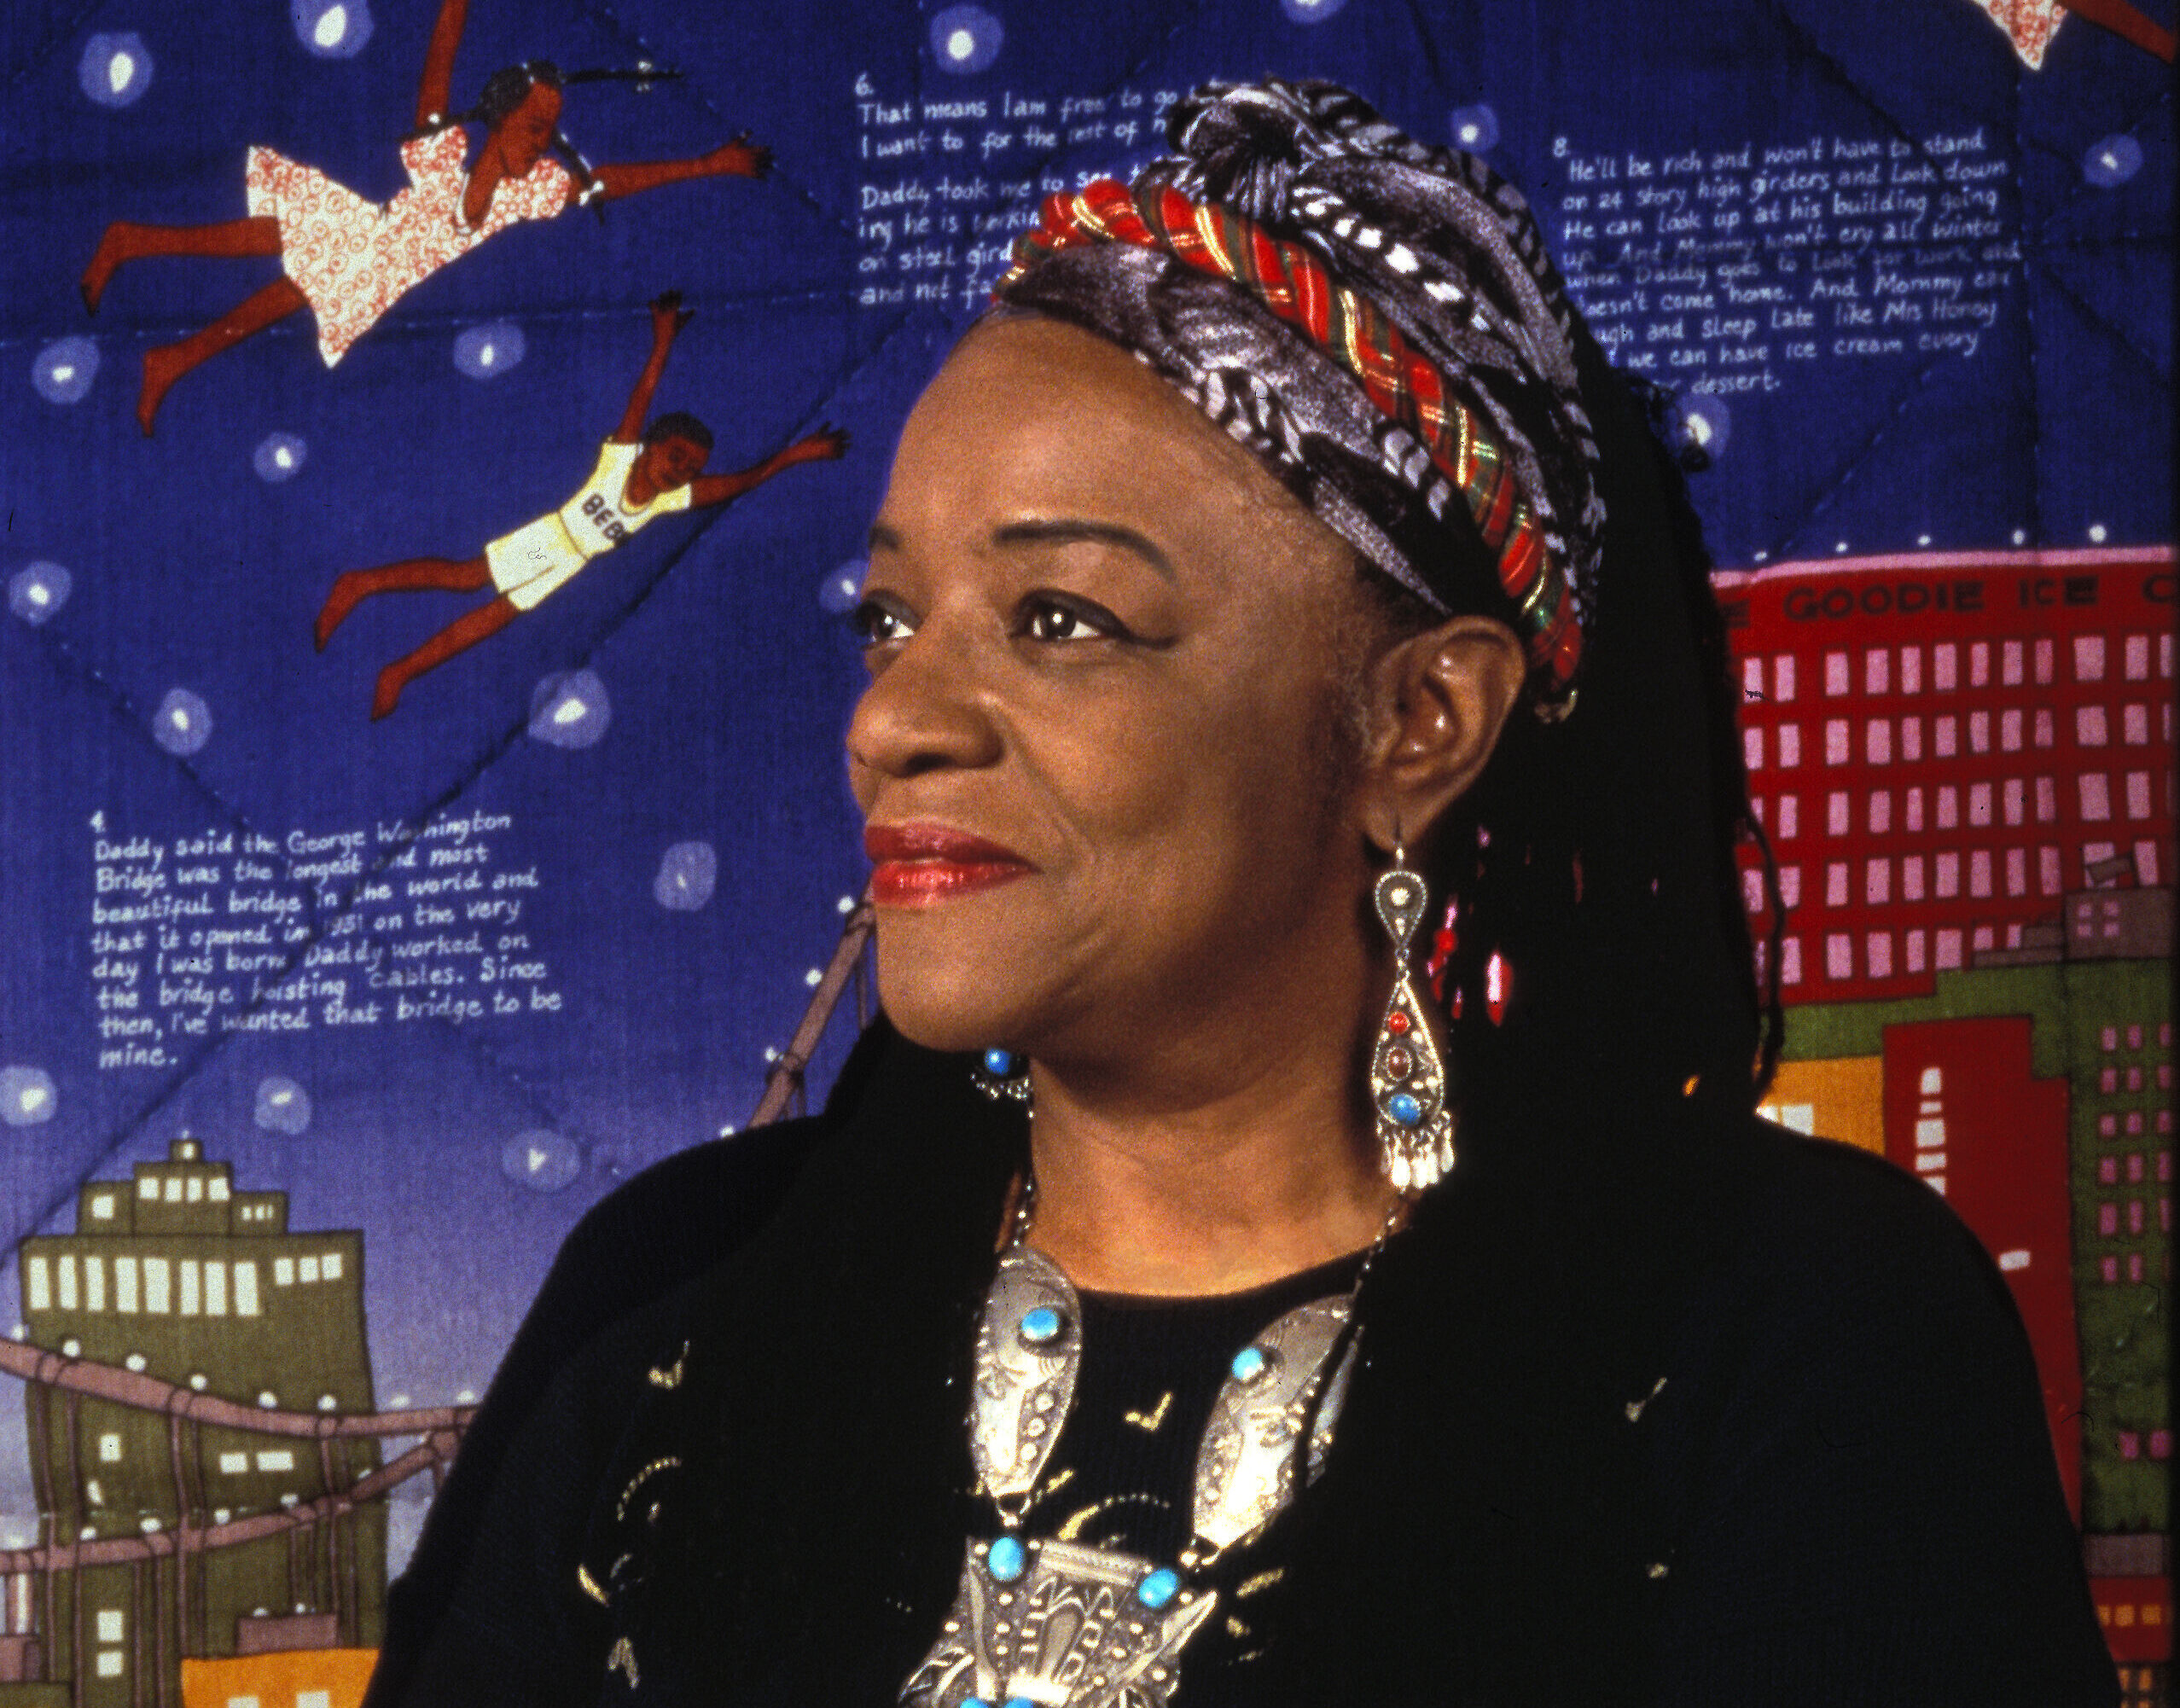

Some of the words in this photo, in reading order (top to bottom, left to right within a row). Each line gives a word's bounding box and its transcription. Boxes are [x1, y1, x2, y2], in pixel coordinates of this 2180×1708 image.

[858, 102, 911, 125] That
[924, 99, 987, 119] means
[1014, 99, 1046, 118] am
[1061, 96, 1106, 123] free
[1120, 87, 1142, 109] to
[1154, 90, 1178, 116] go
[877, 131, 928, 157] want
[942, 129, 964, 150] to
[981, 130, 1013, 160] for
[1024, 125, 1057, 148] the
[1068, 120, 1104, 143] rest
[1113, 120, 1137, 146] of
[1570, 156, 1616, 182] He'll
[1627, 153, 1653, 177] be
[1663, 149, 1703, 176] rich
[1712, 141, 1751, 170] and
[1764, 137, 1822, 165] won't
[1834, 137, 1880, 159] have
[1889, 137, 1911, 159] to
[1922, 127, 1985, 154] stand
[861, 178, 930, 211] Daddy
[936, 175, 990, 201] took
[1000, 180, 1032, 199] me
[1042, 169, 1064, 192] to
[1598, 190, 1623, 210] 24
[1635, 184, 1688, 213] story
[1698, 175, 1741, 208] high
[1750, 169, 1831, 205] girders
[1837, 163, 1880, 186] and
[1944, 159, 2007, 181] down
[858, 216, 893, 253] ing
[904, 212, 931, 235] he
[941, 207, 958, 234] is
[1564, 220, 1596, 241] He
[1606, 218, 1644, 236] can
[1713, 211, 1741, 235] up
[1754, 201, 1782, 225] at
[1791, 195, 1822, 219] his
[1834, 189, 1927, 225] building
[1940, 183, 1998, 219] going
[1618, 240, 1663, 264] And
[1677, 235, 1756, 263] Mommy
[1765, 223, 1828, 251] won't
[1635, 263, 1706, 291] Daddy
[1717, 262, 1761, 289] goes
[1777, 252, 1799, 273] to
[1981, 240, 2021, 260] and
[860, 279, 905, 305] and
[916, 273, 950, 300] not
[1660, 293, 1715, 312] come
[1811, 277, 1860, 299] And
[1874, 271, 1962, 299] Mommy
[1647, 317, 1684, 342] and
[1835, 301, 1875, 328] like
[1883, 299, 1922, 325] Mrs
[1932, 297, 1997, 328] Honey
[1627, 349, 1658, 369] we
[1670, 348, 1707, 367] can
[1719, 343, 1770, 364] have
[1786, 341, 1818, 359] ice
[1834, 339, 1904, 356] cream
[1919, 330, 1979, 357] every
[1783, 580, 1985, 623] GOODIE
[2017, 575, 2100, 610] ICE
[95, 836, 165, 873] Daddy
[176, 828, 233, 857] said
[242, 832, 278, 855] the
[287, 830, 367, 860] George
[96, 863, 166, 898] Bridge
[176, 865, 220, 886] was
[235, 858, 274, 882] the
[429, 842, 491, 868] most
[92, 892, 214, 925] beautiful
[228, 888, 302, 925] bridge
[316, 886, 339, 909] in
[408, 869, 484, 897] world
[491, 865, 541, 892] and
[91, 929, 148, 954] that
[159, 923, 181, 950] it
[189, 922, 273, 956] opened
[284, 917, 311, 943] in
[374, 913, 404, 932] on
[413, 902, 456, 927] the
[465, 899, 523, 926] very
[91, 956, 140, 987] day
[171, 956, 215, 974] was
[225, 946, 288, 972] born
[303, 938, 384, 973] Daddy
[392, 930, 485, 957] worked
[497, 934, 531, 951] on
[96, 985, 140, 1011] the
[159, 978, 235, 1016] bridge
[480, 953, 548, 982] Since
[100, 1014, 164, 1041] then,
[220, 1006, 311, 1032] wanted
[323, 999, 383, 1024] that
[396, 990, 485, 1025] bridge
[492, 989, 520, 1014] to
[531, 984, 563, 1011] be
